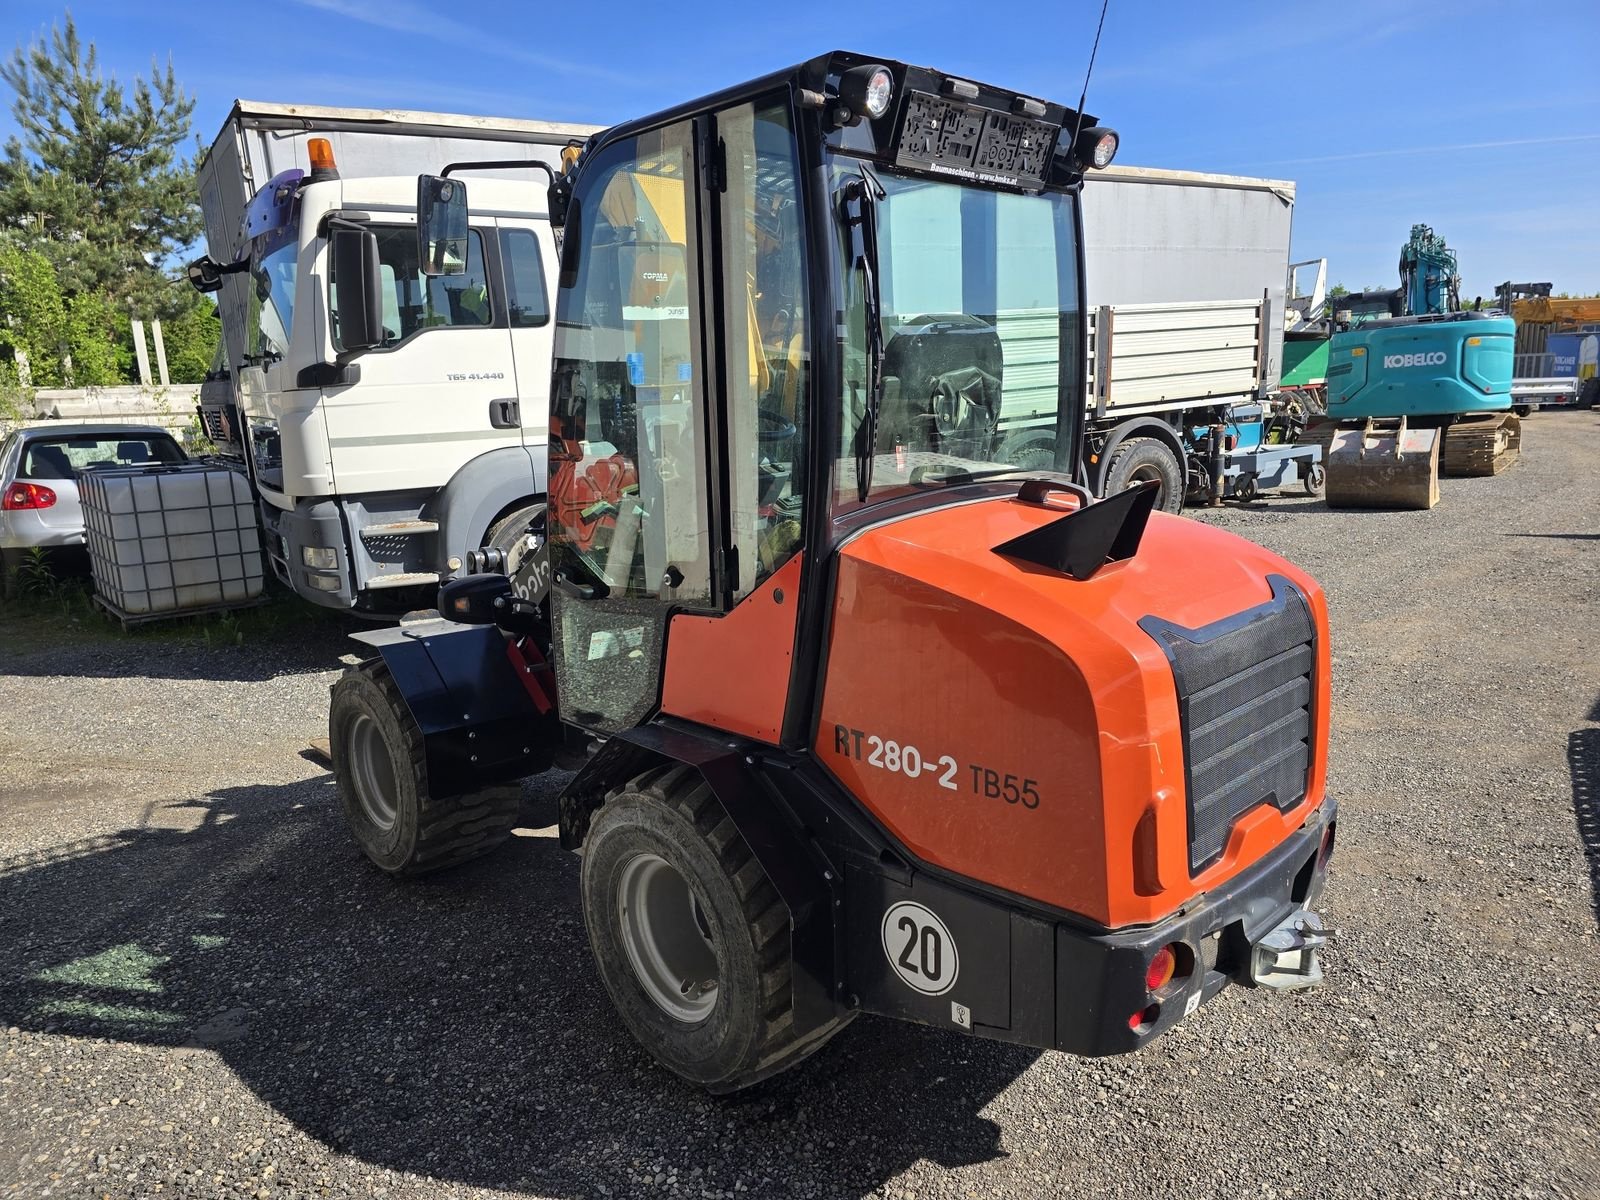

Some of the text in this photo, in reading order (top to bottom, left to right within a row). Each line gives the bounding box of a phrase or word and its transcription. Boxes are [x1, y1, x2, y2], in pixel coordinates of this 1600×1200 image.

[930, 163, 975, 178] Baumaschinen
[979, 173, 1017, 185] www.bmks.at
[1384, 352, 1447, 368] KOBELCO
[468, 372, 504, 380] 41.440
[969, 765, 1040, 810] TB55
[898, 916, 942, 981] 20
